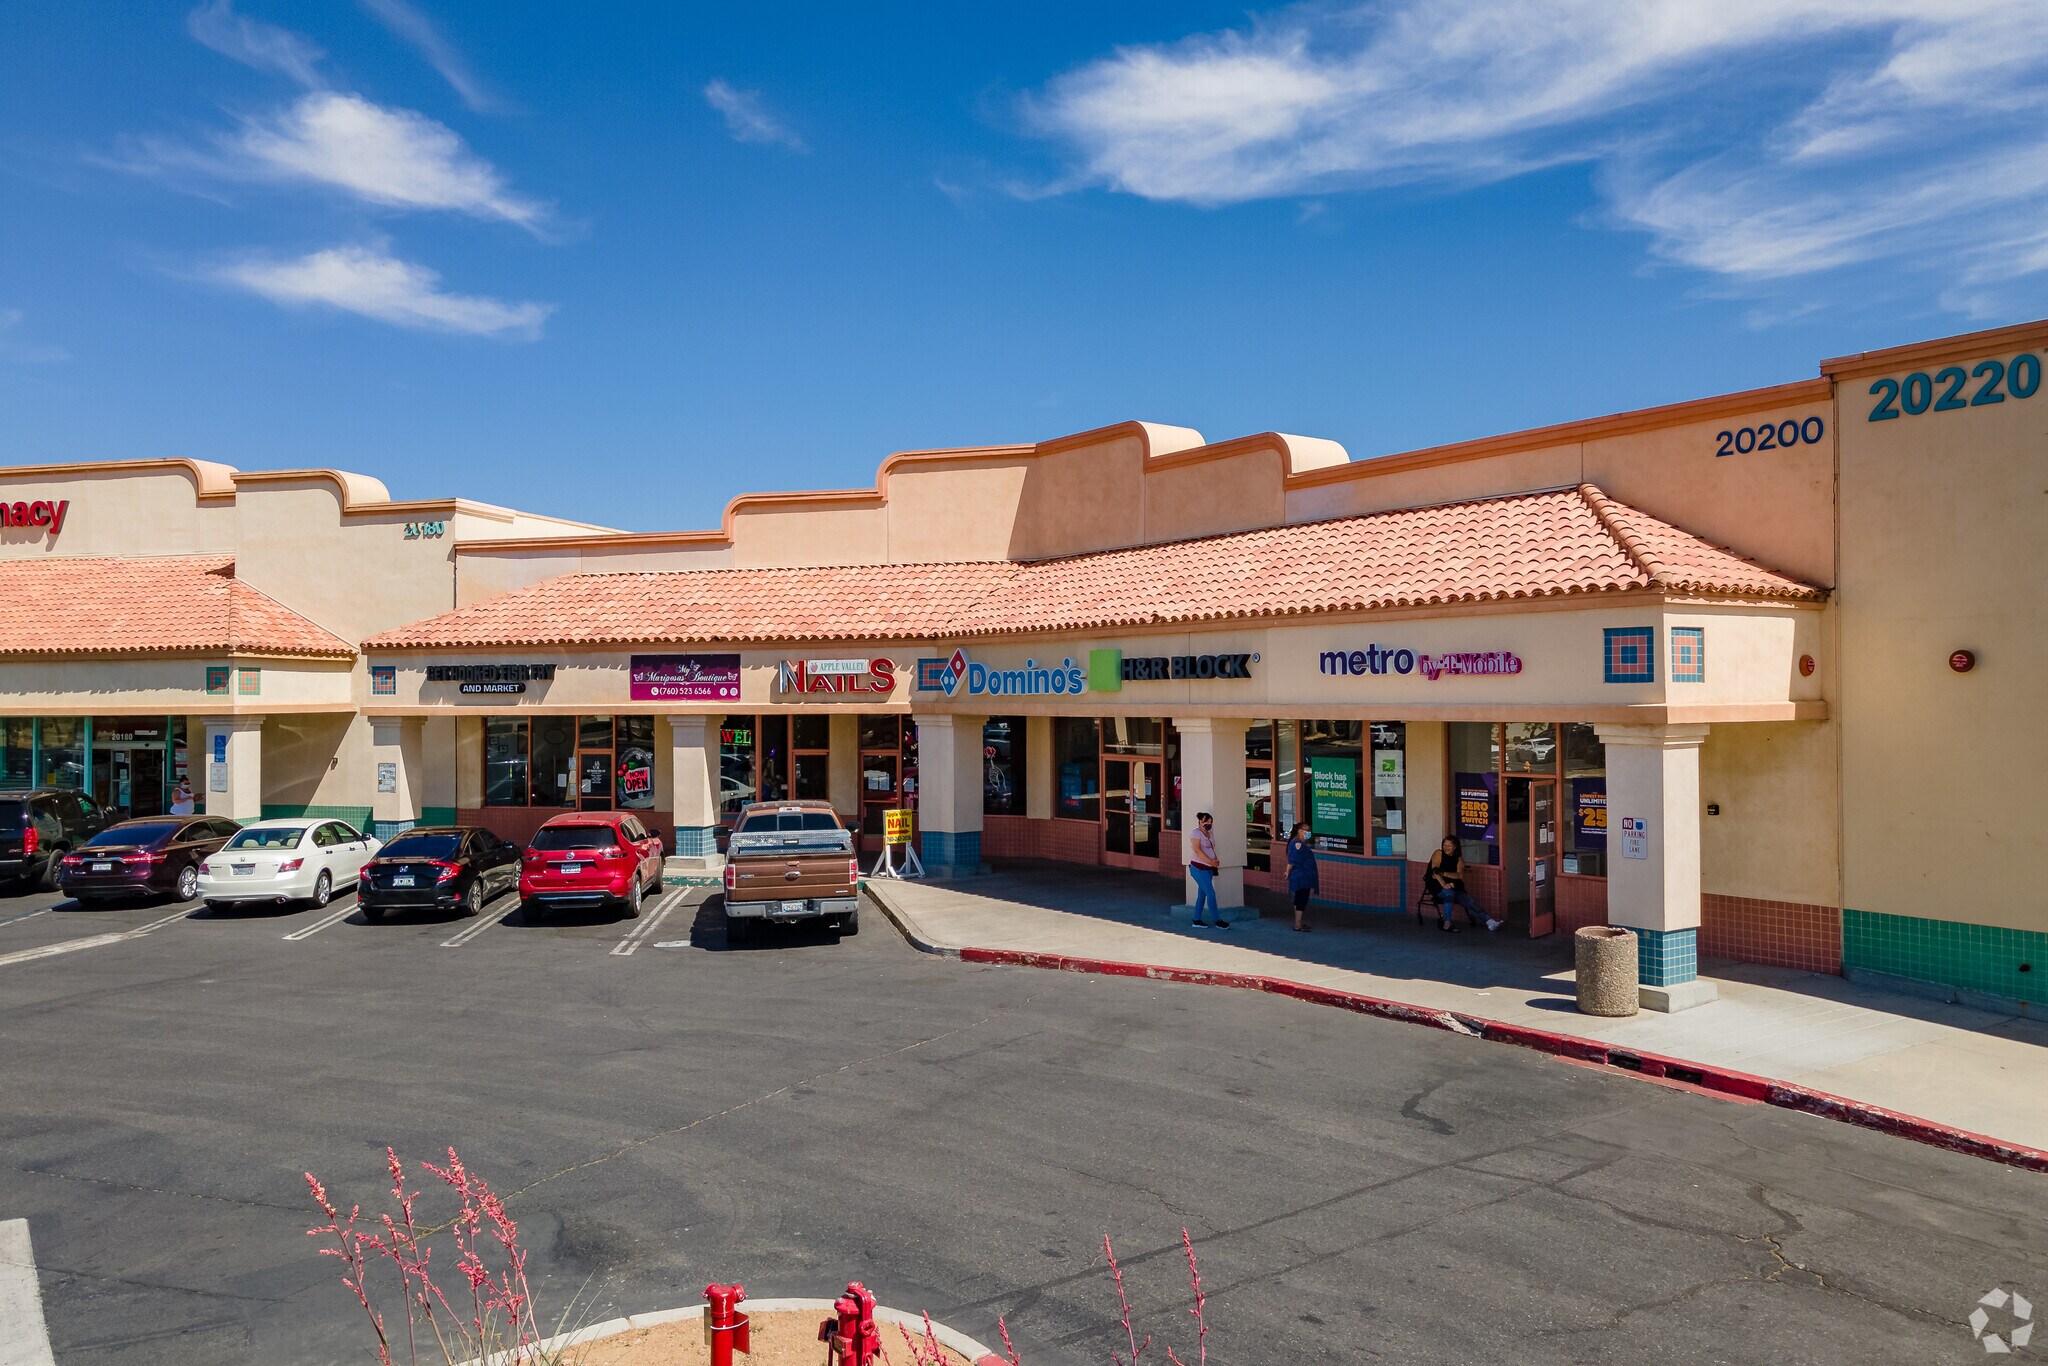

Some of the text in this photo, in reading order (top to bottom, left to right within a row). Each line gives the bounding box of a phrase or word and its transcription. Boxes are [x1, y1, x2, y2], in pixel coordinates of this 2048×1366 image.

[1868, 353, 2041, 422] 20220
[1716, 416, 1824, 457] 20200
[820, 661, 864, 671] APPLE VALLEY
[1320, 643, 1414, 675] metro
[1420, 655, 1440, 680] by
[427, 664, 554, 680] GET HOOKED FISH FRY
[676, 664, 690, 676] My
[1121, 658, 1169, 680] H&R
[1171, 654, 1250, 679] BLOCK
[644, 670, 727, 686] Mariposas Boutique
[780, 658, 896, 693] NAILS
[968, 657, 1085, 696] Domino's
[463, 684, 519, 692] AND MARKET
[660, 687, 711, 696] (760) 523 6566
[630, 769, 645, 778] NOW
[1314, 771, 1347, 780] Block has
[626, 777, 648, 791] OPEN
[1330, 780, 1347, 789] back
[1315, 789, 1353, 798] year-round.
[1461, 801, 1488, 811] ZERO
[1461, 817, 1488, 825] SWITCH
[1578, 807, 1607, 827] $25
[888, 818, 909, 828] NAIL
[1623, 819, 1633, 828] NO
[1624, 830, 1645, 839] PARKING
